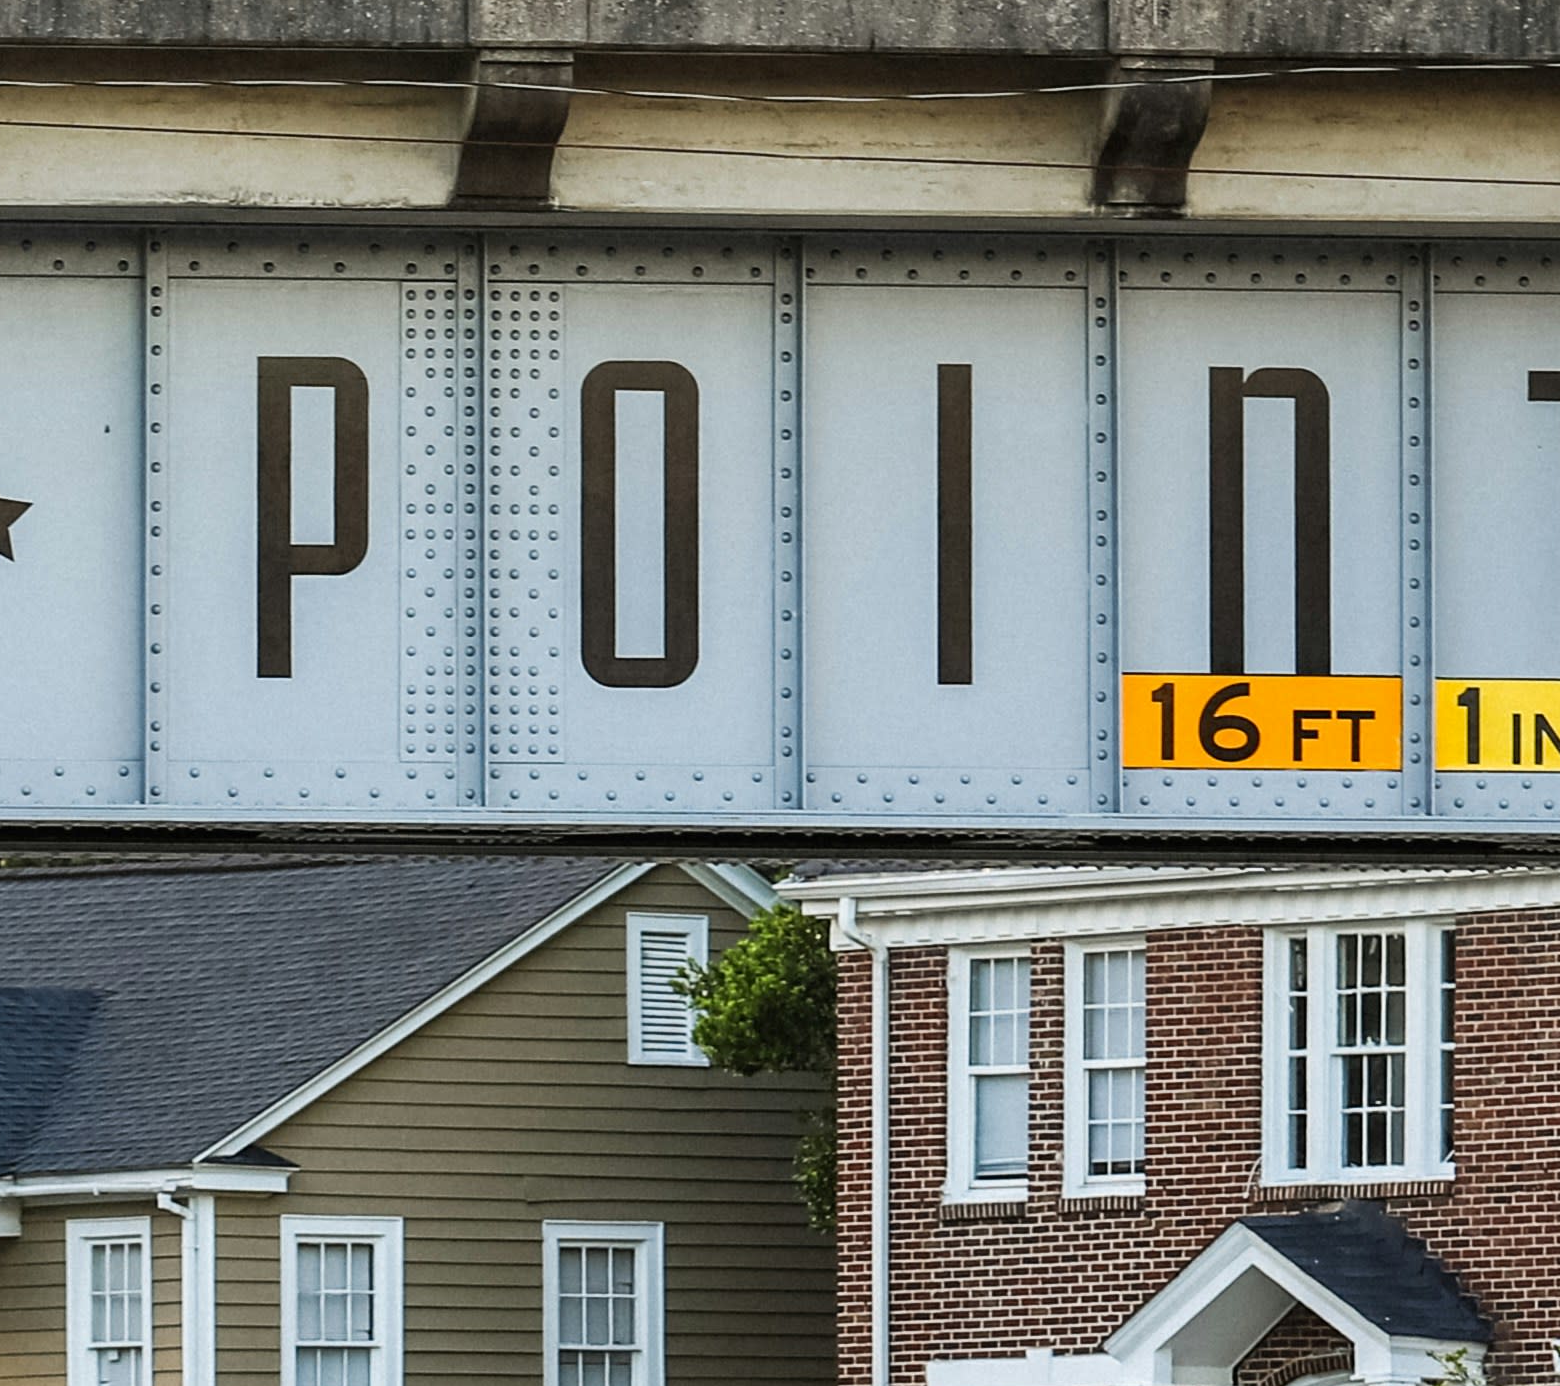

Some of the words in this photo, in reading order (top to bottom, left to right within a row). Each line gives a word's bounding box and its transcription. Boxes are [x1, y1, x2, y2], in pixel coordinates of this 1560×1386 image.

[1152, 684, 1261, 763] 16
[1292, 709, 1377, 763] FT
[1456, 686, 1482, 765] 1
